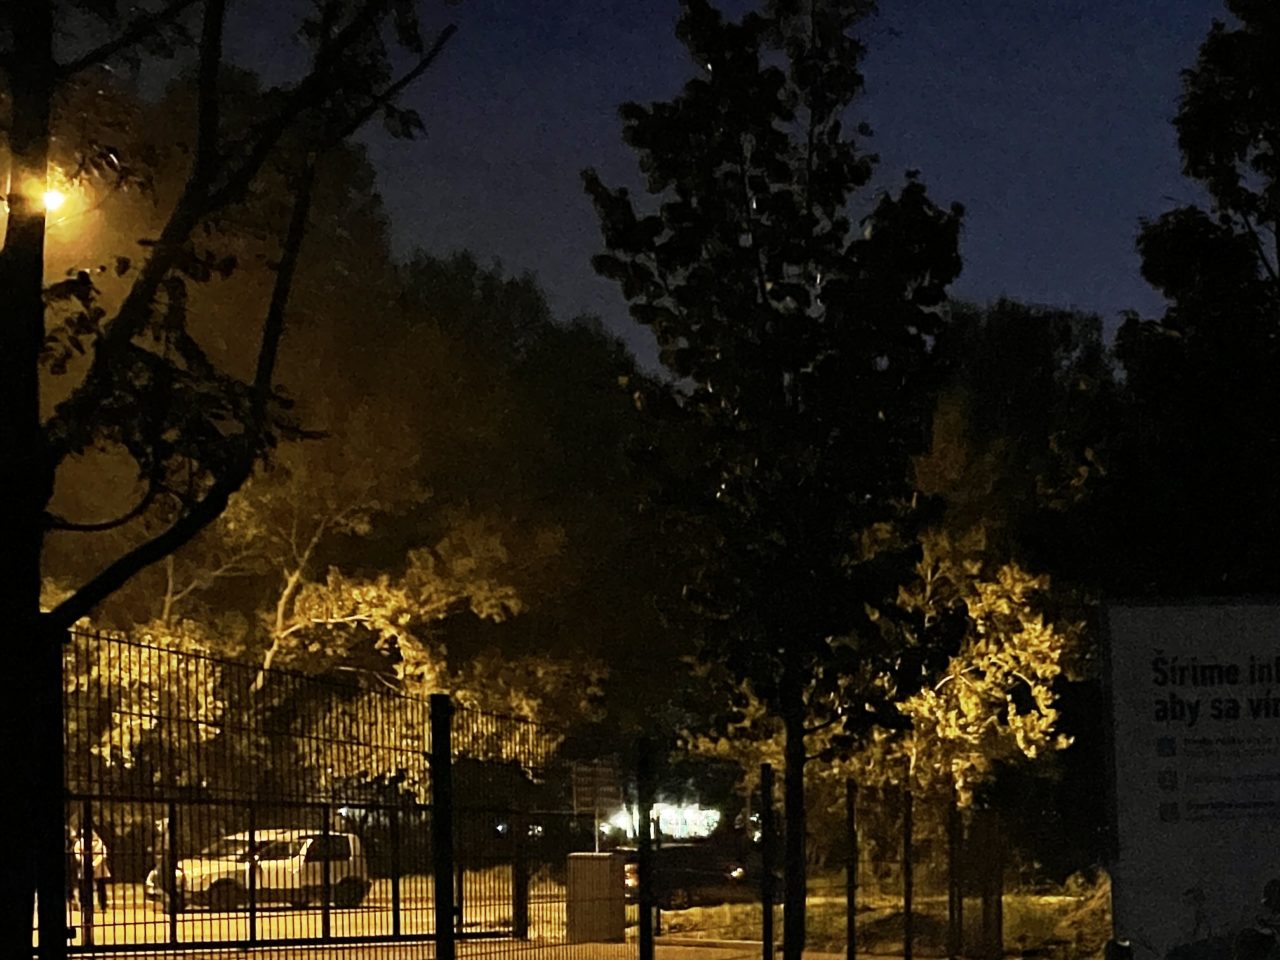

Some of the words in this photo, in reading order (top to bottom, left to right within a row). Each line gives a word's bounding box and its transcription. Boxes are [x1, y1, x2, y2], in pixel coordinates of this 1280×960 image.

[1152, 648, 1240, 687] Šírime
[1154, 692, 1201, 728] aby
[1210, 697, 1240, 720] sa
